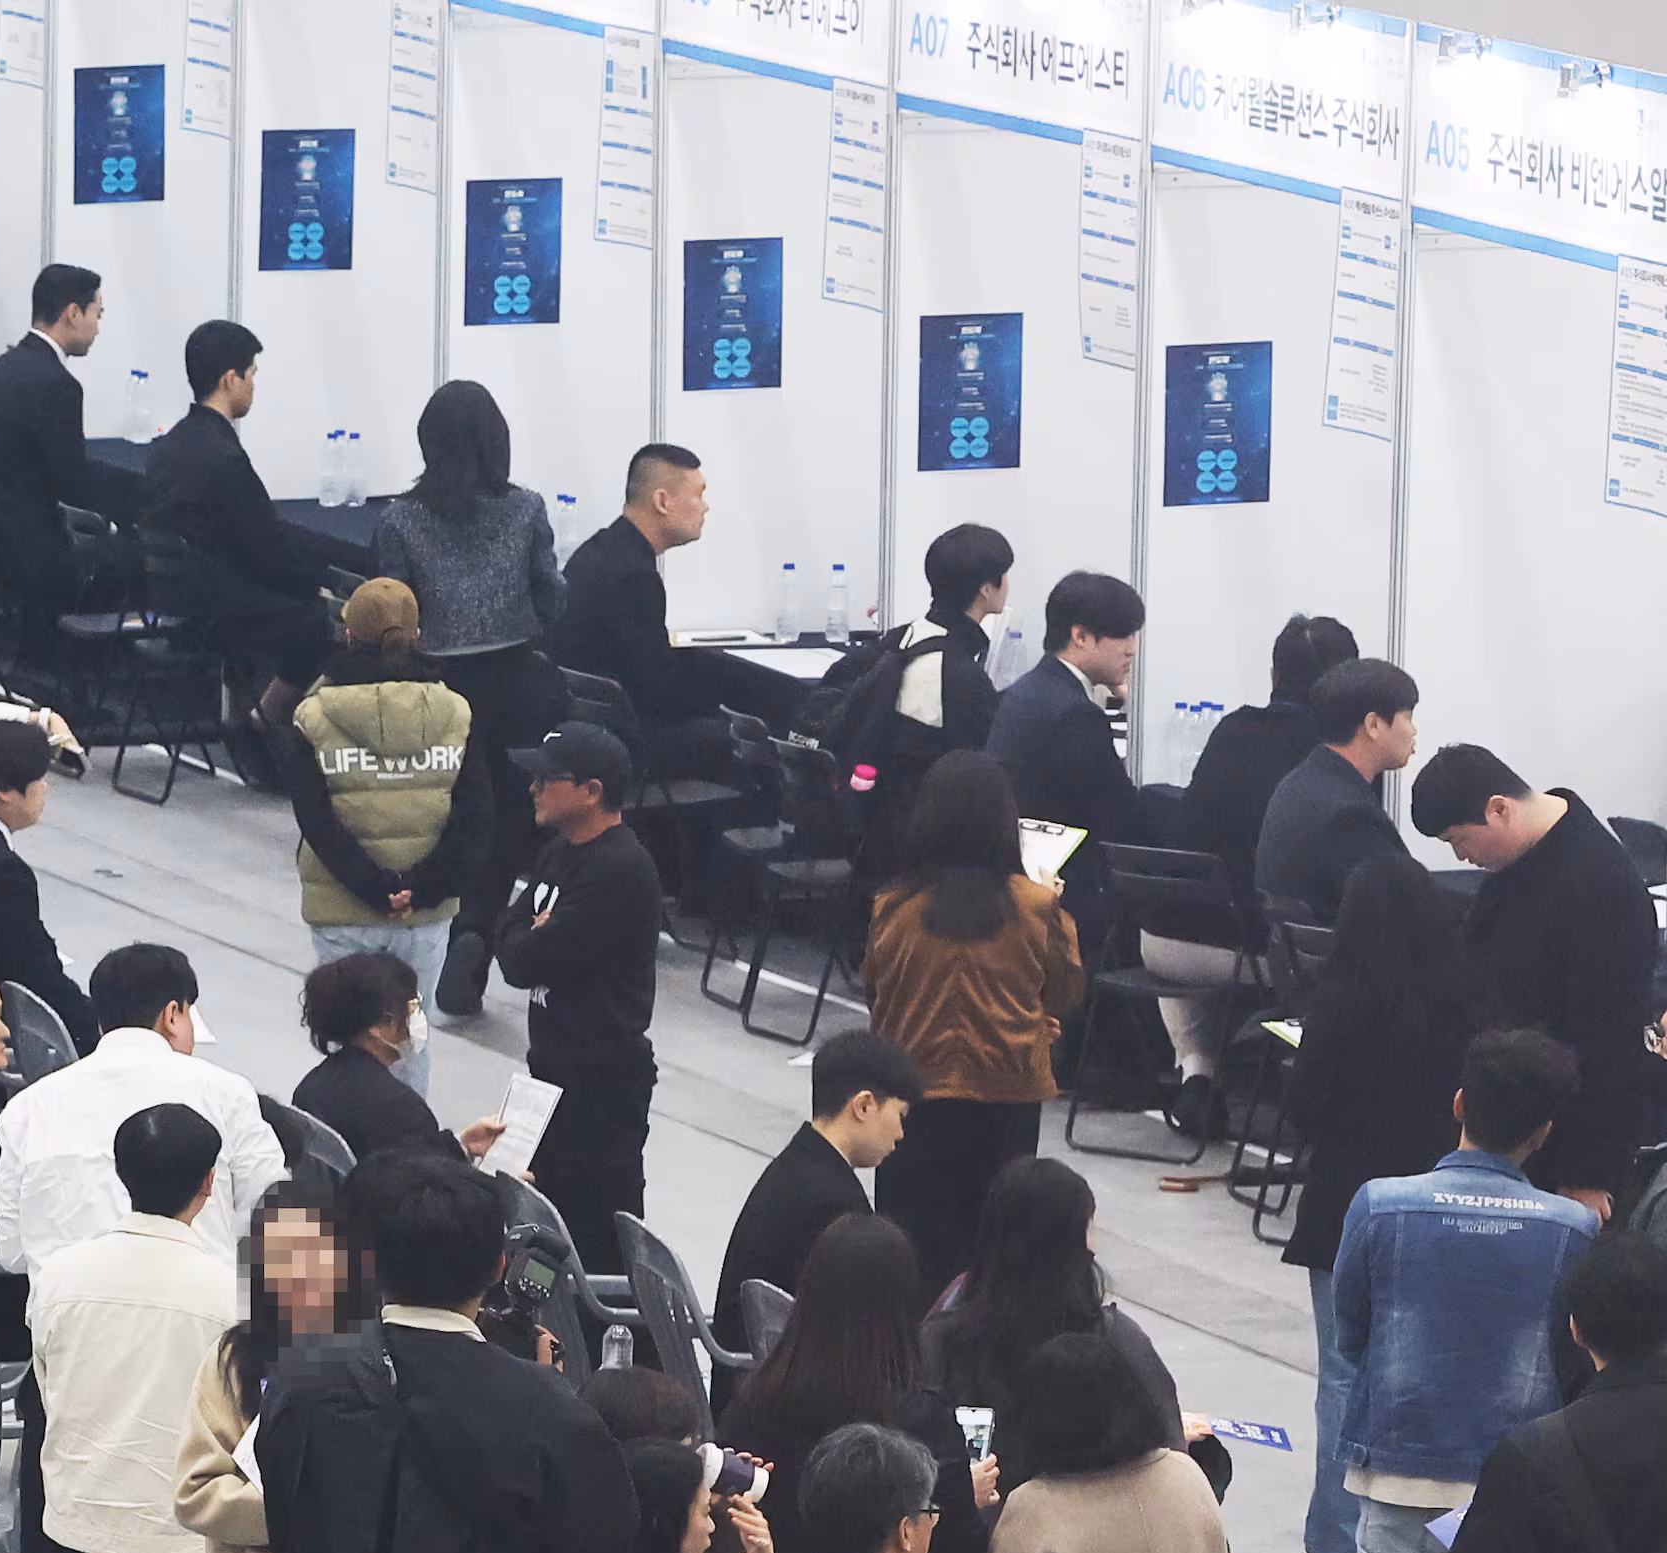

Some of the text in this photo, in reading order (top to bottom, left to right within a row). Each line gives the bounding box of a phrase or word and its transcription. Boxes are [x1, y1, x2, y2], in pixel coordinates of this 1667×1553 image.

[910, 12, 949, 59] A07
[967, 22, 1036, 81] 주식회사
[1163, 63, 1207, 112] A06
[1333, 98, 1400, 160] 주식회사
[1426, 120, 1469, 172] A05
[1487, 133, 1564, 199] 주식회사
